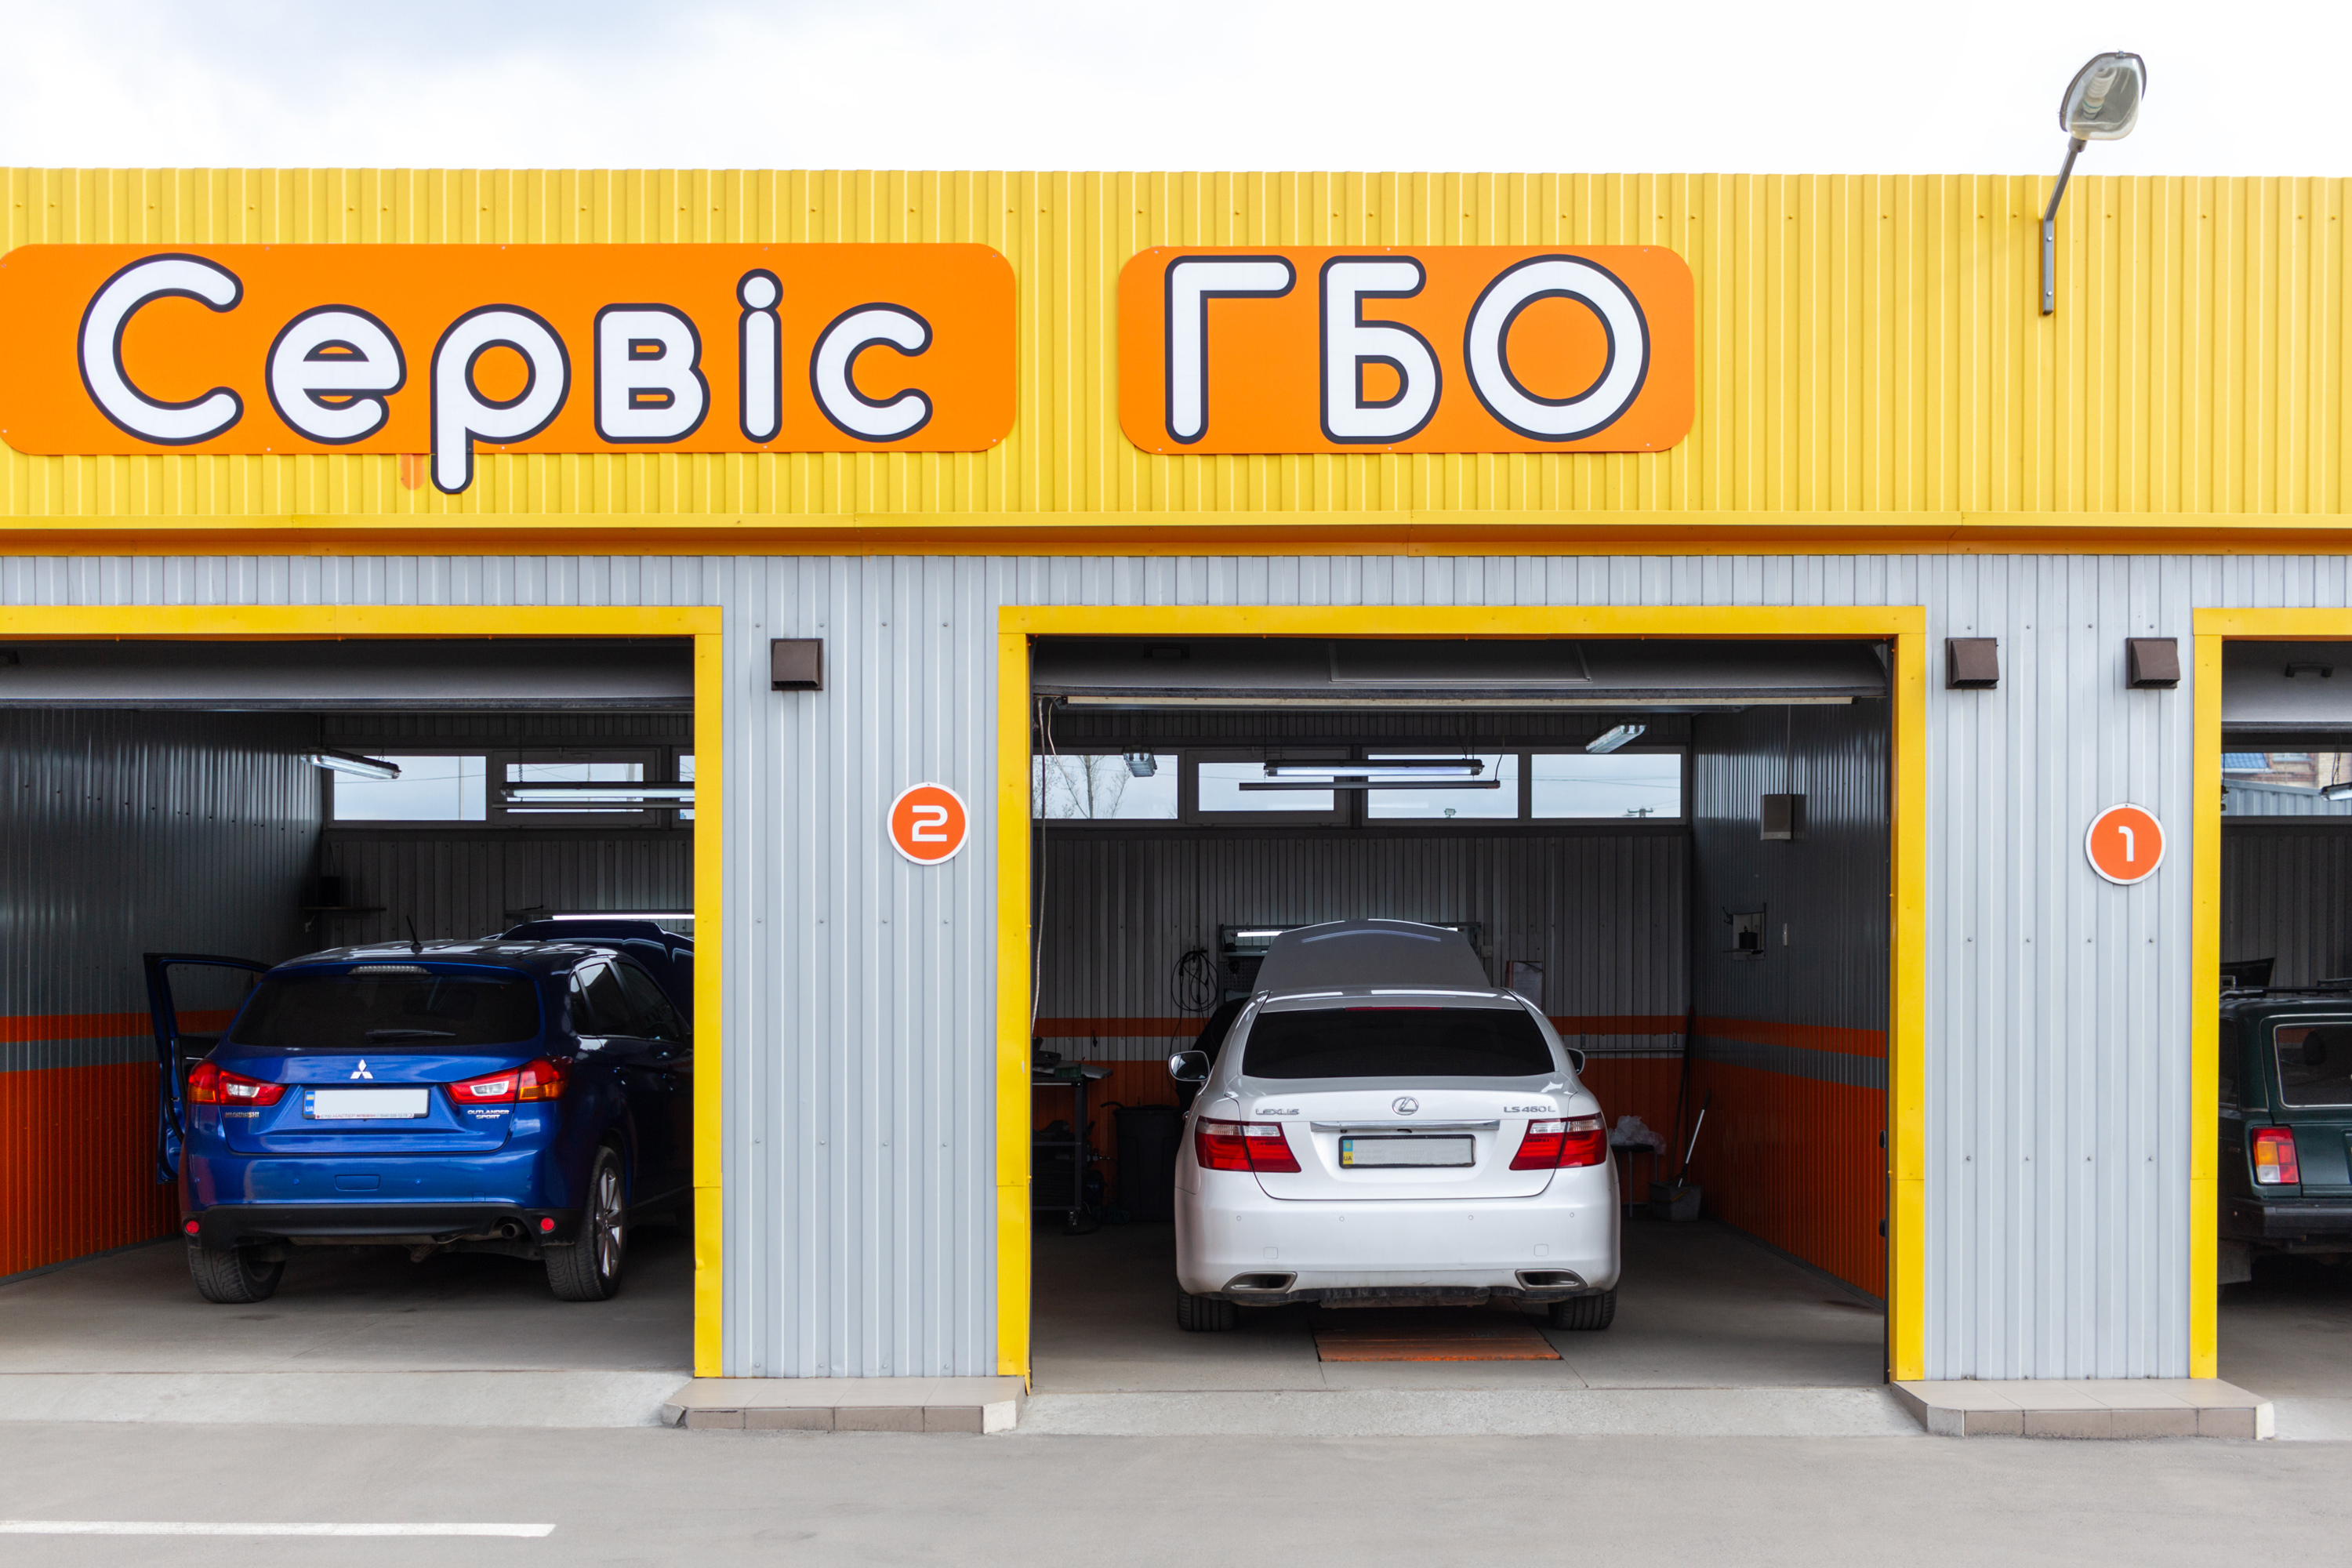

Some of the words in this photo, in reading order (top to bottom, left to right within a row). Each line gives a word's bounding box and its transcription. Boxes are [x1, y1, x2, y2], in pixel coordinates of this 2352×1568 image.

[77, 252, 934, 495] Сервіс
[1164, 253, 1651, 445] ГБО
[912, 805, 949, 842] 2
[2118, 826, 2134, 862] 1
